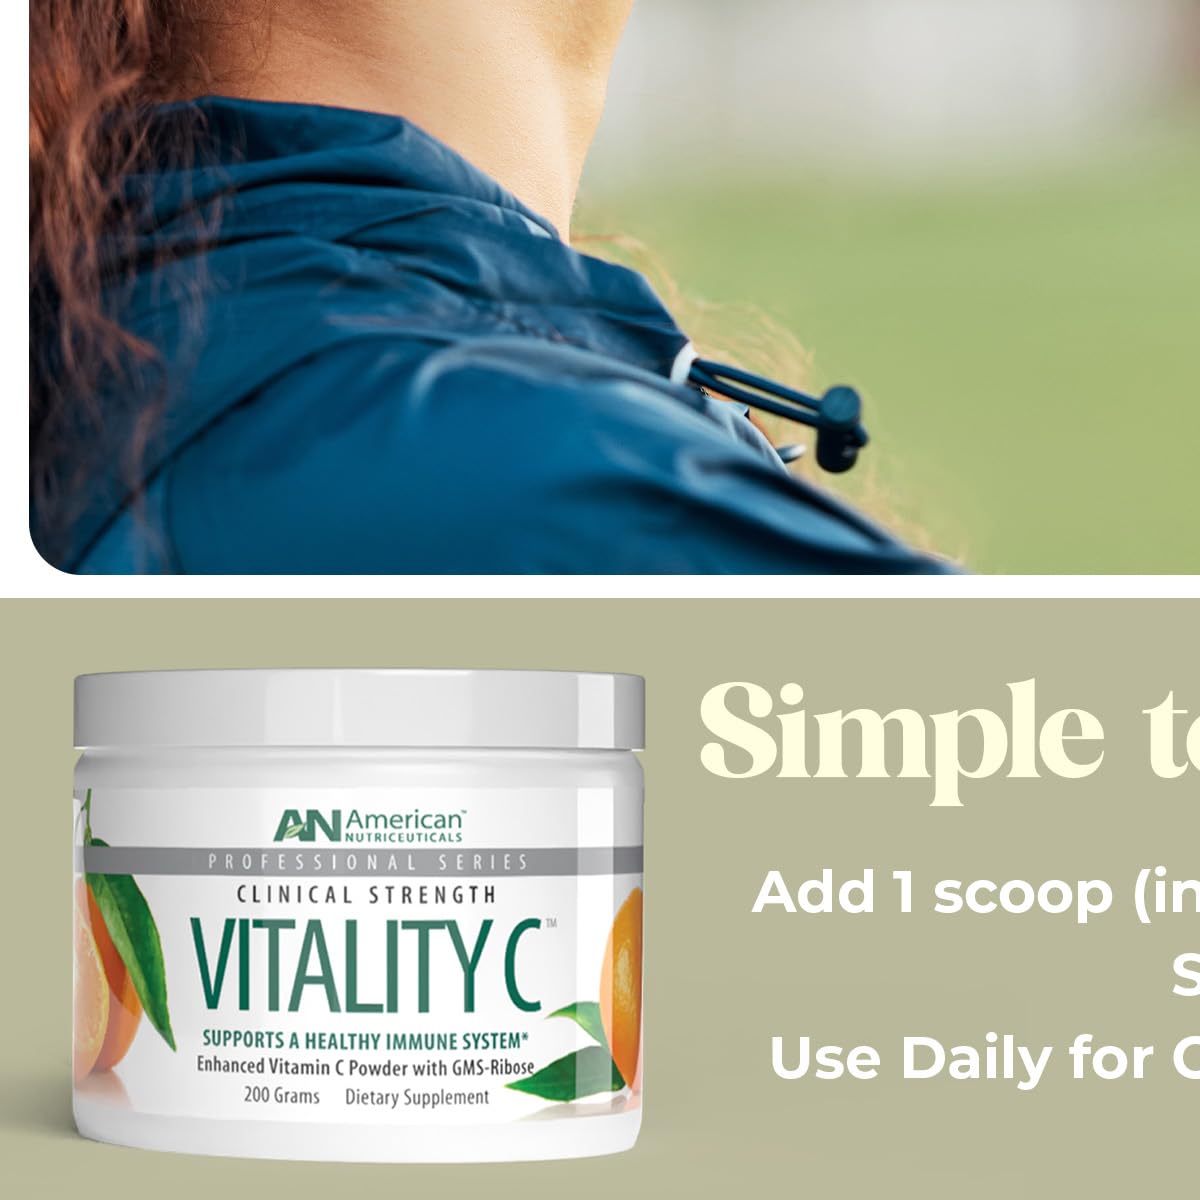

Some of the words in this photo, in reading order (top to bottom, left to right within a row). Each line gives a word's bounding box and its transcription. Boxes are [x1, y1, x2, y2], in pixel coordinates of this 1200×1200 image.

[345, 832, 463, 843] NUTRICEUTICALS
[208, 853, 416, 871] PROFESSIONAL
[439, 853, 528, 871] SERIES
[237, 885, 352, 903] CLINICAL
[369, 885, 495, 904] STRENGTH
[190, 917, 493, 1013] VITALITY
[504, 918, 541, 1012] C
[202, 1029, 284, 1049] SUPPORTS
[288, 1031, 300, 1049] A
[305, 1031, 380, 1050] HEALTHY
[386, 1032, 458, 1051] IMMUNE
[197, 1056, 265, 1074] Enhanced
[269, 1057, 330, 1076] Vitamin
[335, 1059, 344, 1076] C
[349, 1059, 409, 1077] Powder
[413, 1059, 448, 1076] with
[452, 1058, 535, 1077] GMS-Ribose
[244, 1086, 269, 1103] 200
[274, 1086, 320, 1104] Grams
[345, 1088, 399, 1110] Dietary
[404, 1088, 489, 1109] Supplement
